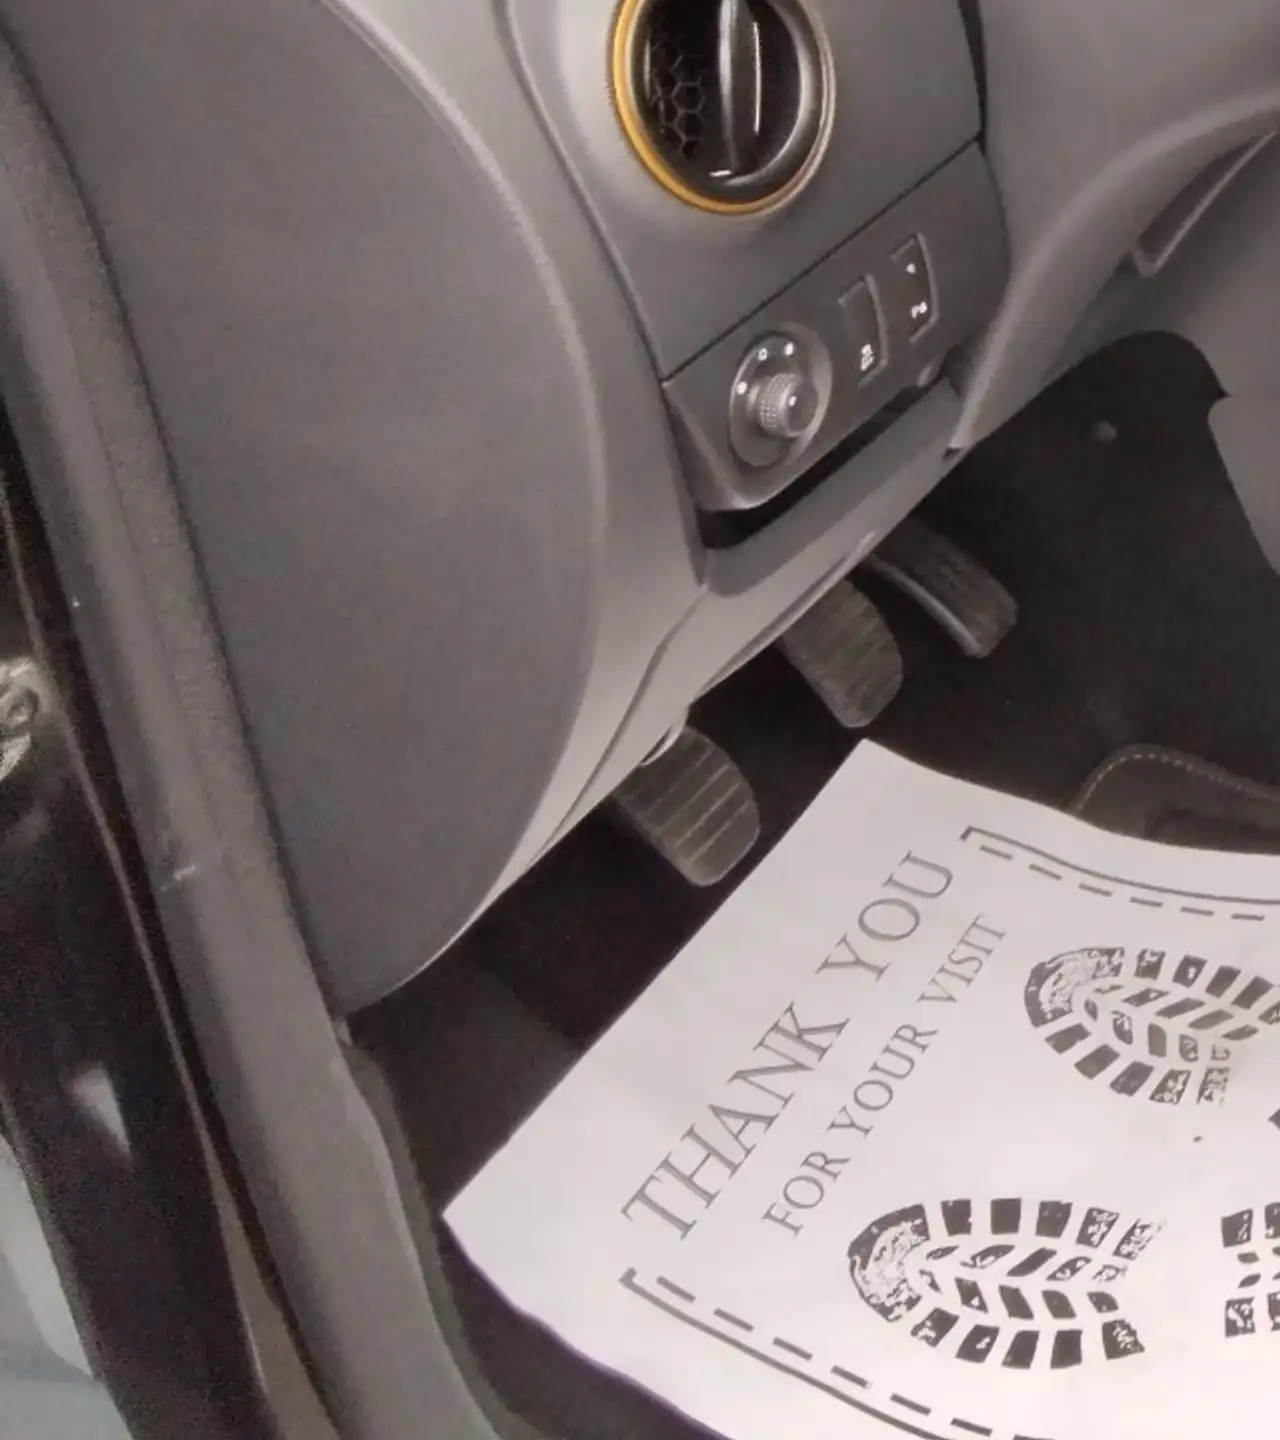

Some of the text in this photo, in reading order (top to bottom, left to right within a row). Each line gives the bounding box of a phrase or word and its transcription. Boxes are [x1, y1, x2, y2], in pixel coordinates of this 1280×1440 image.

[620, 850, 954, 1241] THANK YOU
[761, 914, 1006, 1238] FOR YOUR VISIT
